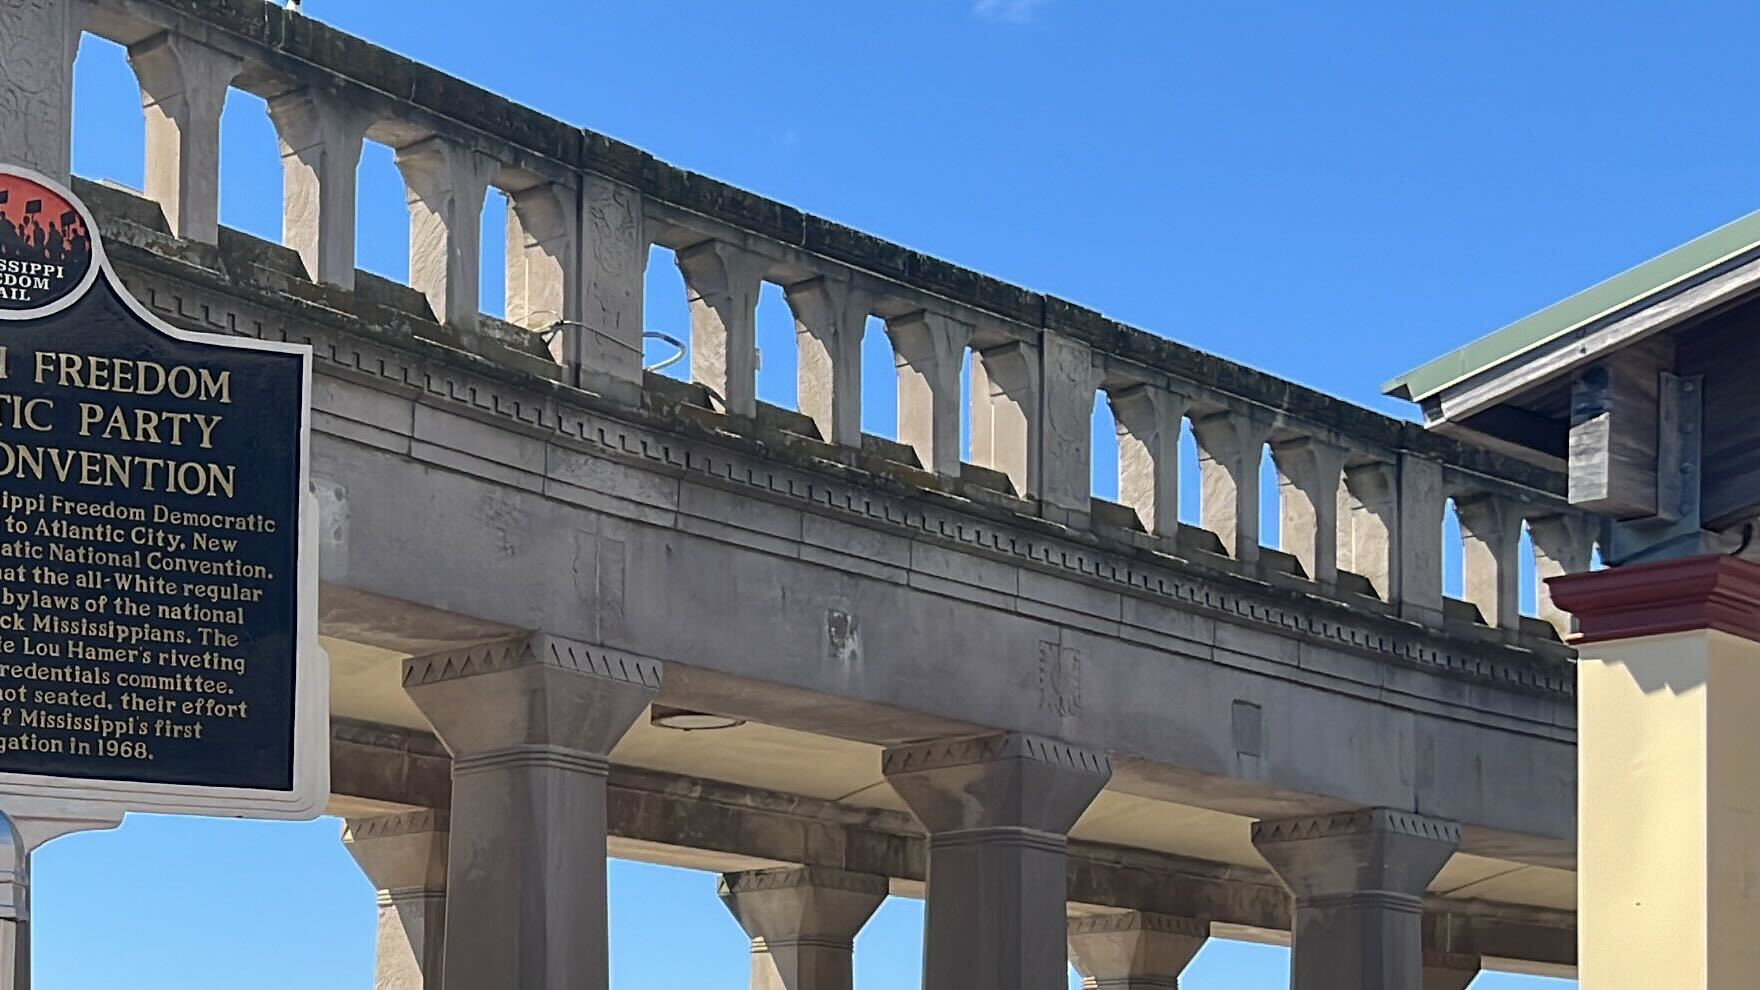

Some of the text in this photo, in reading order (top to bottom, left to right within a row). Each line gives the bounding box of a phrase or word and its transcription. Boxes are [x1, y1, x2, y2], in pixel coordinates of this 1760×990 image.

[34, 351, 231, 403] FREEDOM
[79, 403, 222, 448] PARTY
[52, 495, 145, 521] Freedom
[153, 504, 275, 532] Democratic
[5, 515, 28, 534] to
[34, 518, 124, 543] Atlantic
[192, 532, 238, 552] New
[49, 543, 141, 568] National
[147, 552, 273, 579] Convention.
[32, 566, 69, 586] the
[76, 570, 177, 595] all-White
[182, 583, 262, 602] regular
[2, 587, 79, 611] bylaws
[85, 595, 108, 613] of
[113, 597, 150, 616] the
[158, 602, 244, 624] national
[32, 613, 192, 644] Mississippians.
[197, 627, 238, 647] The
[23, 637, 60, 657] Lou
[158, 649, 245, 676] riveting
[116, 673, 234, 694] committee.
[120, 692, 176, 713] their
[182, 697, 247, 718] effort
[154, 719, 202, 739] first
[70, 736, 90, 755] in
[98, 739, 153, 760] 1968.
